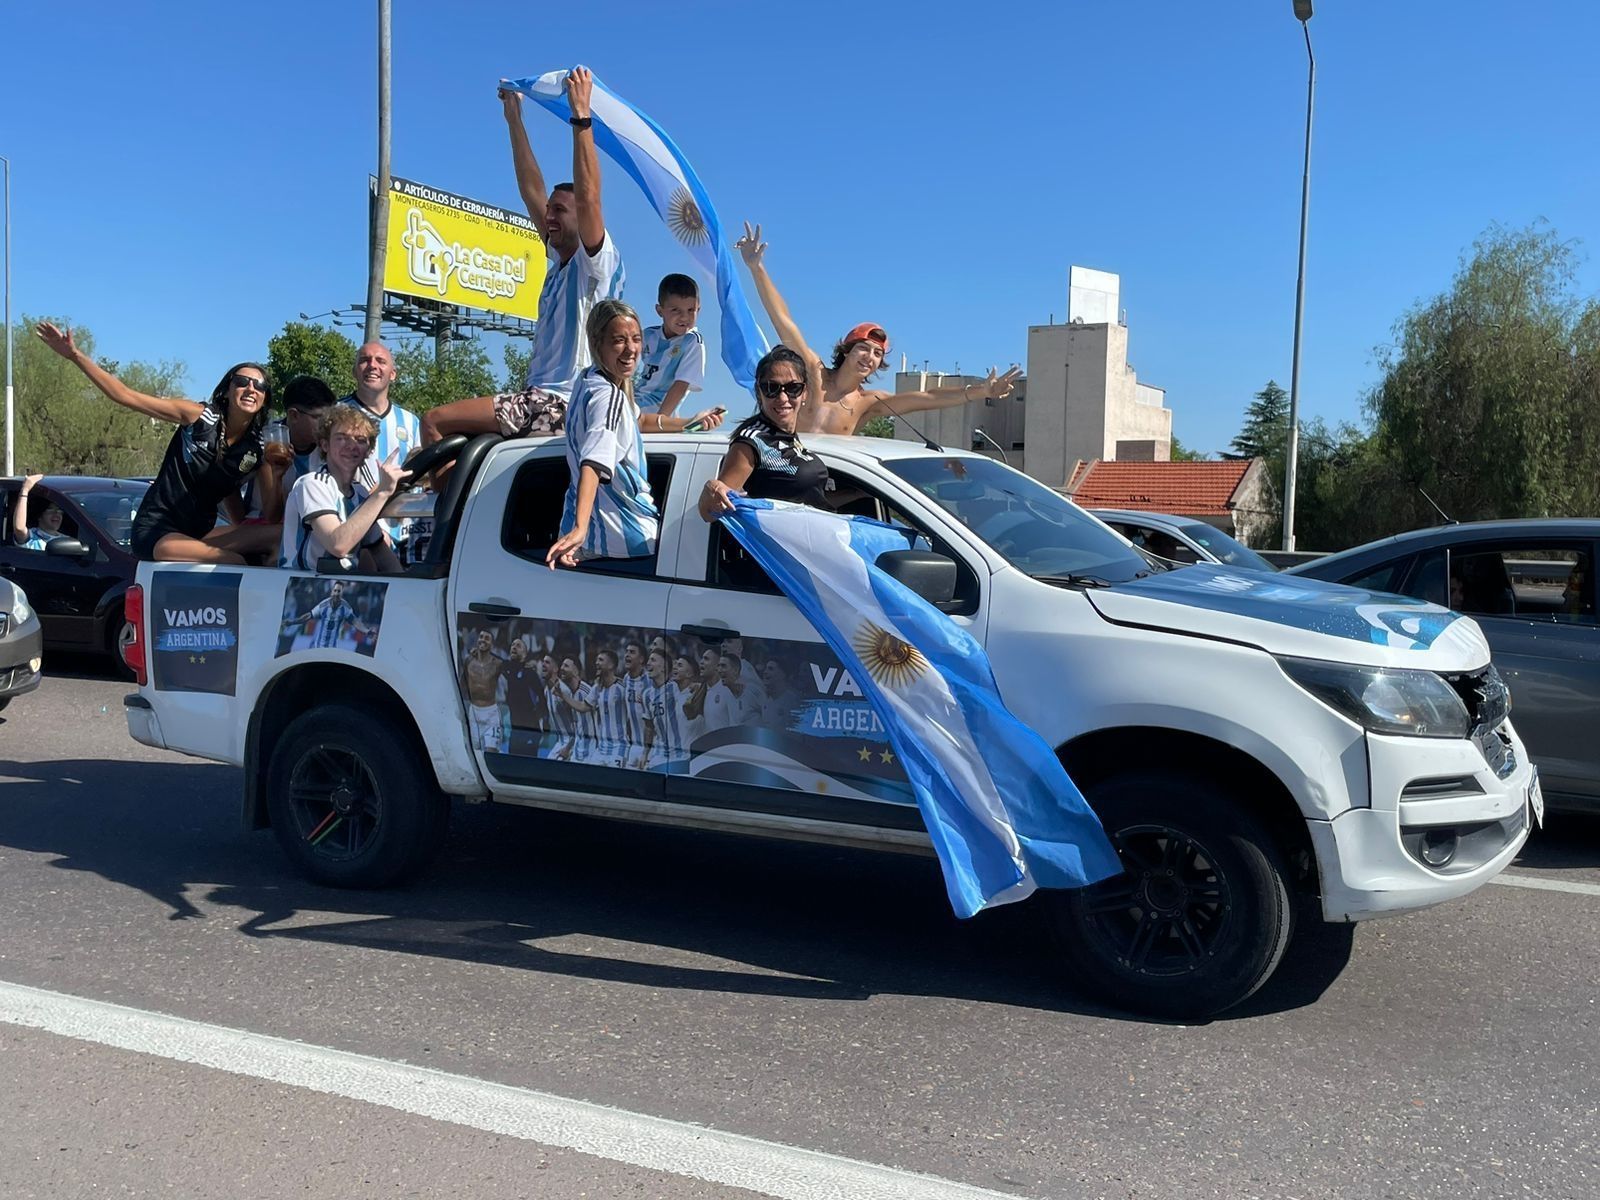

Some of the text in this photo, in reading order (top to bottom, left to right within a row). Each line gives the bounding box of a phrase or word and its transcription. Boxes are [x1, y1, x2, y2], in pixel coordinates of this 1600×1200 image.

[404, 183, 449, 205] ARTÍCULOS
[450, 197, 462, 208] DE
[461, 200, 505, 221] CERRAJERÍA
[509, 214, 538, 231] HERRAJ
[496, 222, 509, 233] 261
[454, 244, 524, 279] La Casa Del
[459, 267, 514, 295] Cerrajero
[163, 607, 227, 627] VAMOS
[166, 632, 228, 647] ARGENTINA
[809, 662, 864, 697] VA
[811, 706, 886, 733] ARGEN
